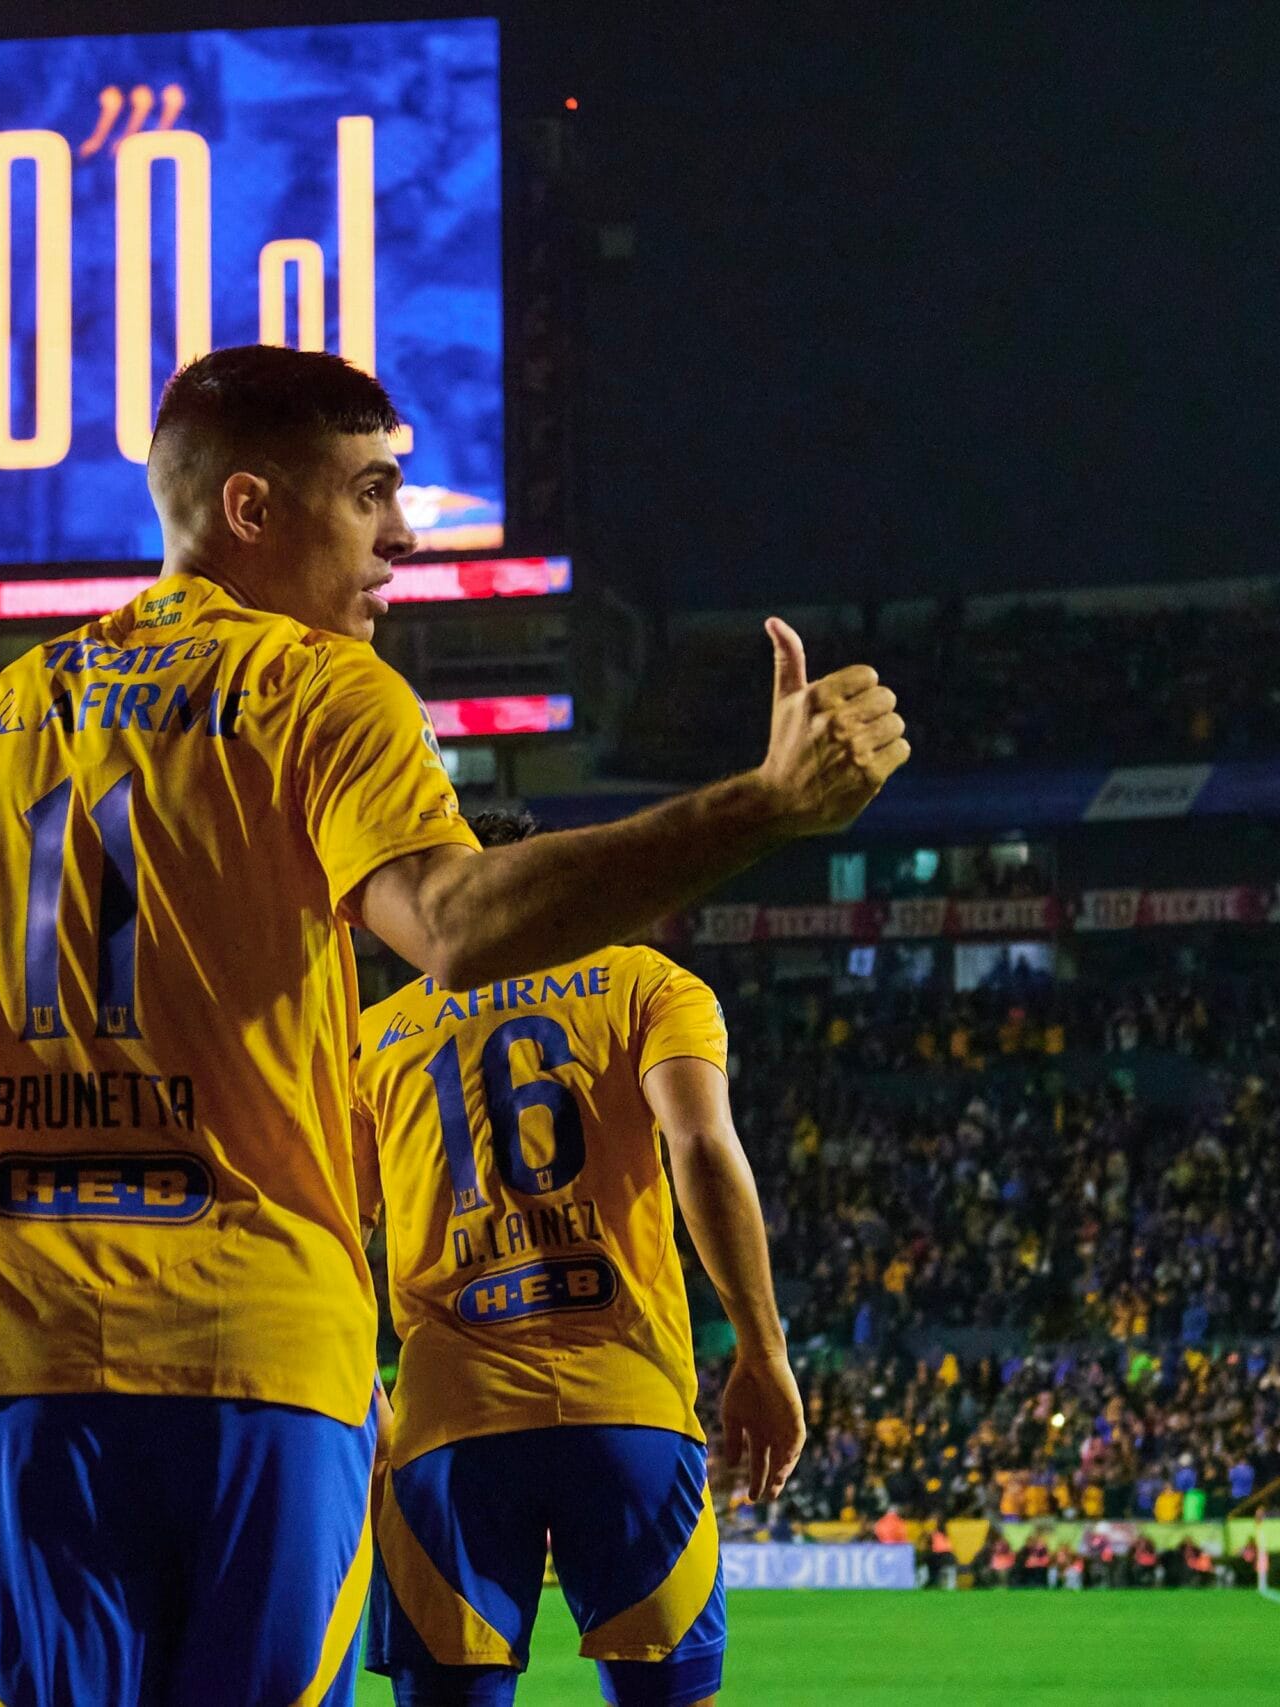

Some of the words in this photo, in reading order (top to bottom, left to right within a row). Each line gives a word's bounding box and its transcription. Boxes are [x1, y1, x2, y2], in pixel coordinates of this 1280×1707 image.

[44, 637, 196, 675] TECATE
[20, 772, 143, 1041] 11
[435, 967, 611, 1028] AFIRME
[424, 1015, 586, 1217] 16
